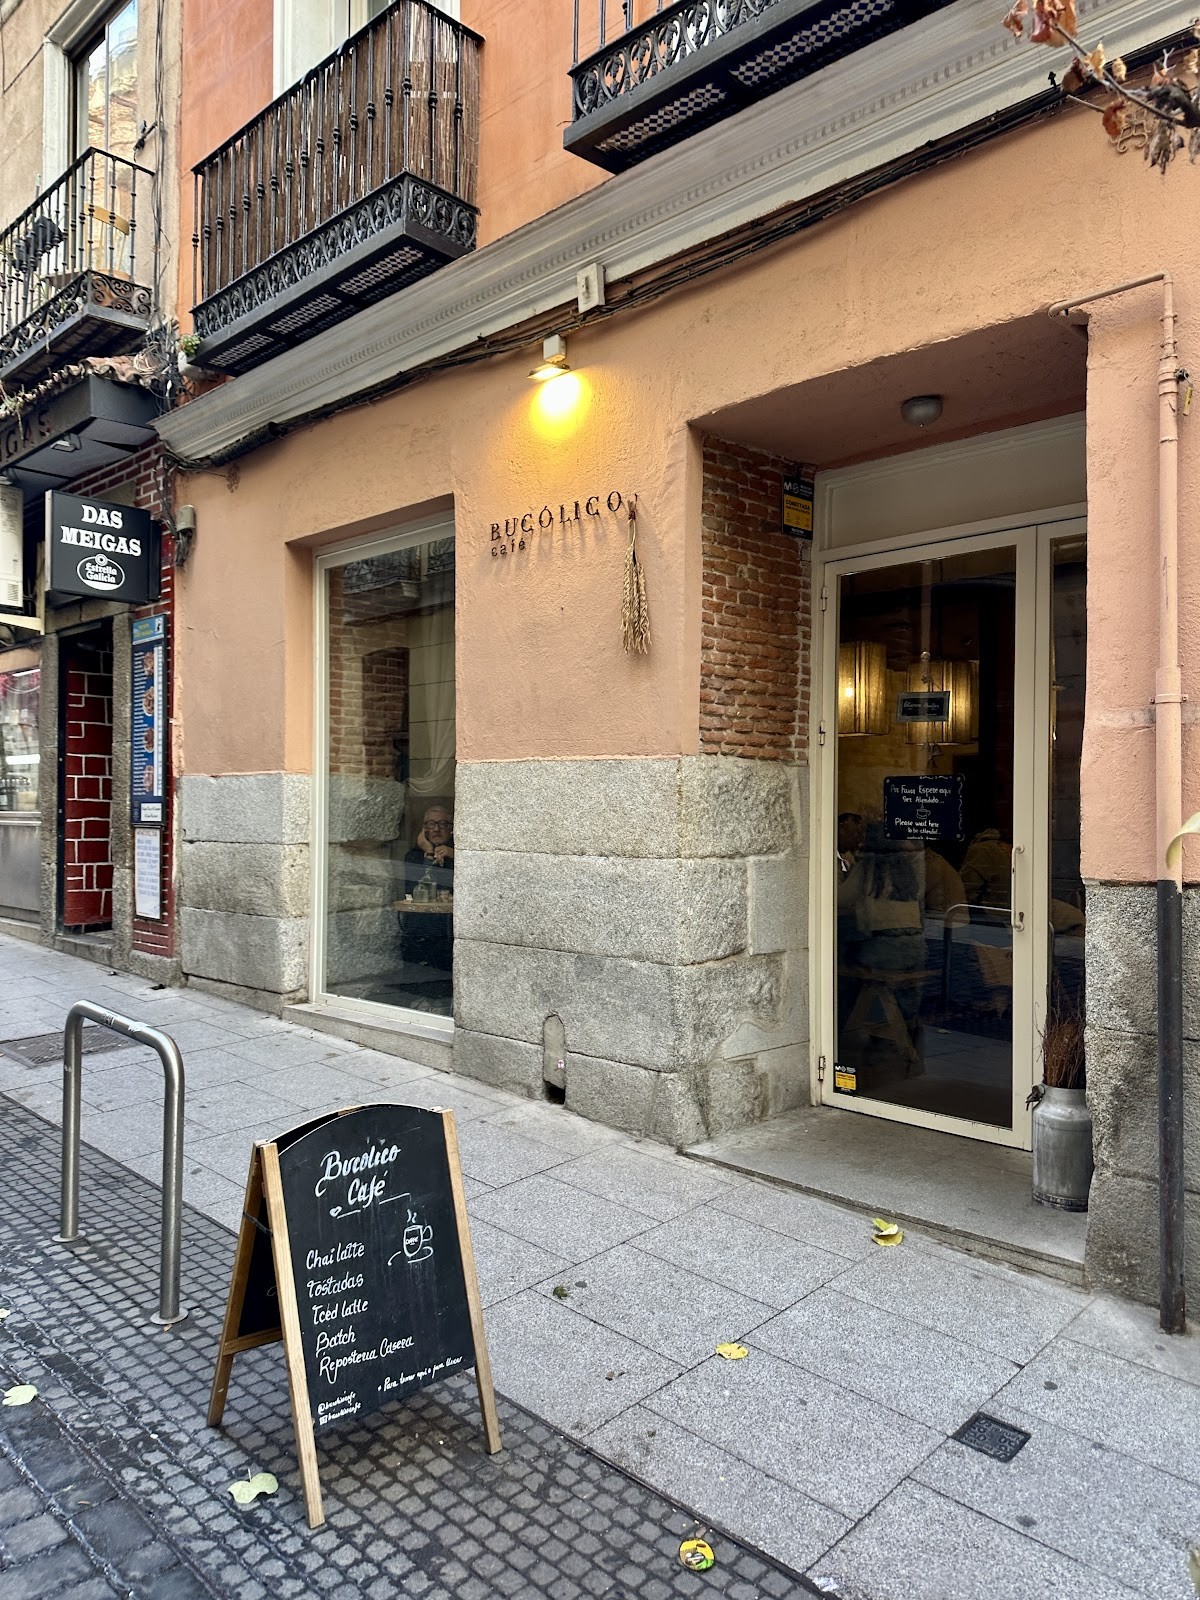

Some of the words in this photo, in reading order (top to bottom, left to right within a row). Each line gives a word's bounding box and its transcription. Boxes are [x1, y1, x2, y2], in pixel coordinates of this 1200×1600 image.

[81, 504, 123, 530] DAS
[490, 491, 622, 541] BUCÓLICO
[60, 525, 142, 557] MEIGAS
[491, 537, 526, 557] café
[85, 562, 117, 576] Estrella
[86, 570, 116, 583] Galicia
[894, 817, 913, 826] Please
[928, 819, 939, 828] here
[347, 1170, 389, 1208] Café
[306, 1247, 334, 1270] Chai
[336, 1241, 365, 1262] latte
[306, 1271, 364, 1298] Tostadas
[341, 1299, 368, 1318] latte
[315, 1325, 356, 1358] Batch
[379, 1336, 414, 1357] Casera
[383, 1376, 399, 1392] Para
